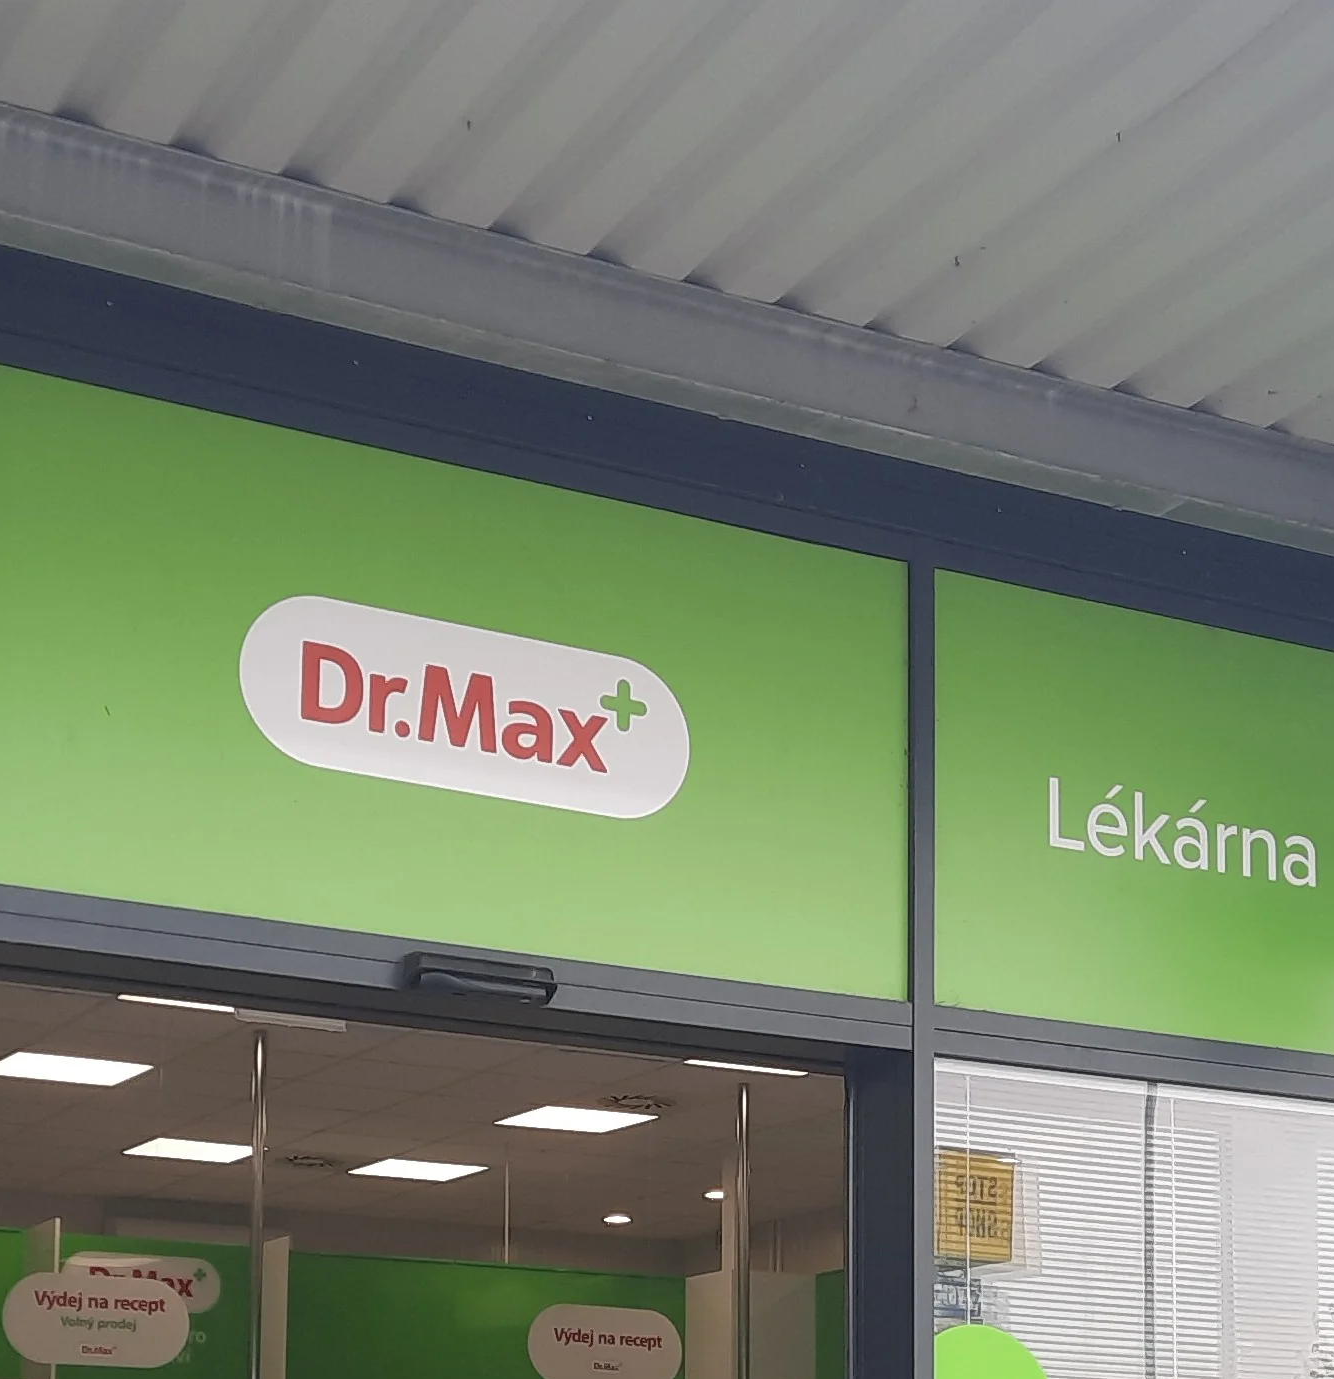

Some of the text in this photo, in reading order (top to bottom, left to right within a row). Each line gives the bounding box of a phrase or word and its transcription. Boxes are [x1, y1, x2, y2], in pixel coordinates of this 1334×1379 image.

[299, 639, 610, 774] Dr.Max
[1048, 776, 1318, 888] Lékárna
[34, 1290, 167, 1316] Výdej na recept
[60, 1316, 137, 1333] Volný prodej
[553, 1327, 663, 1352] Výdej na recept
